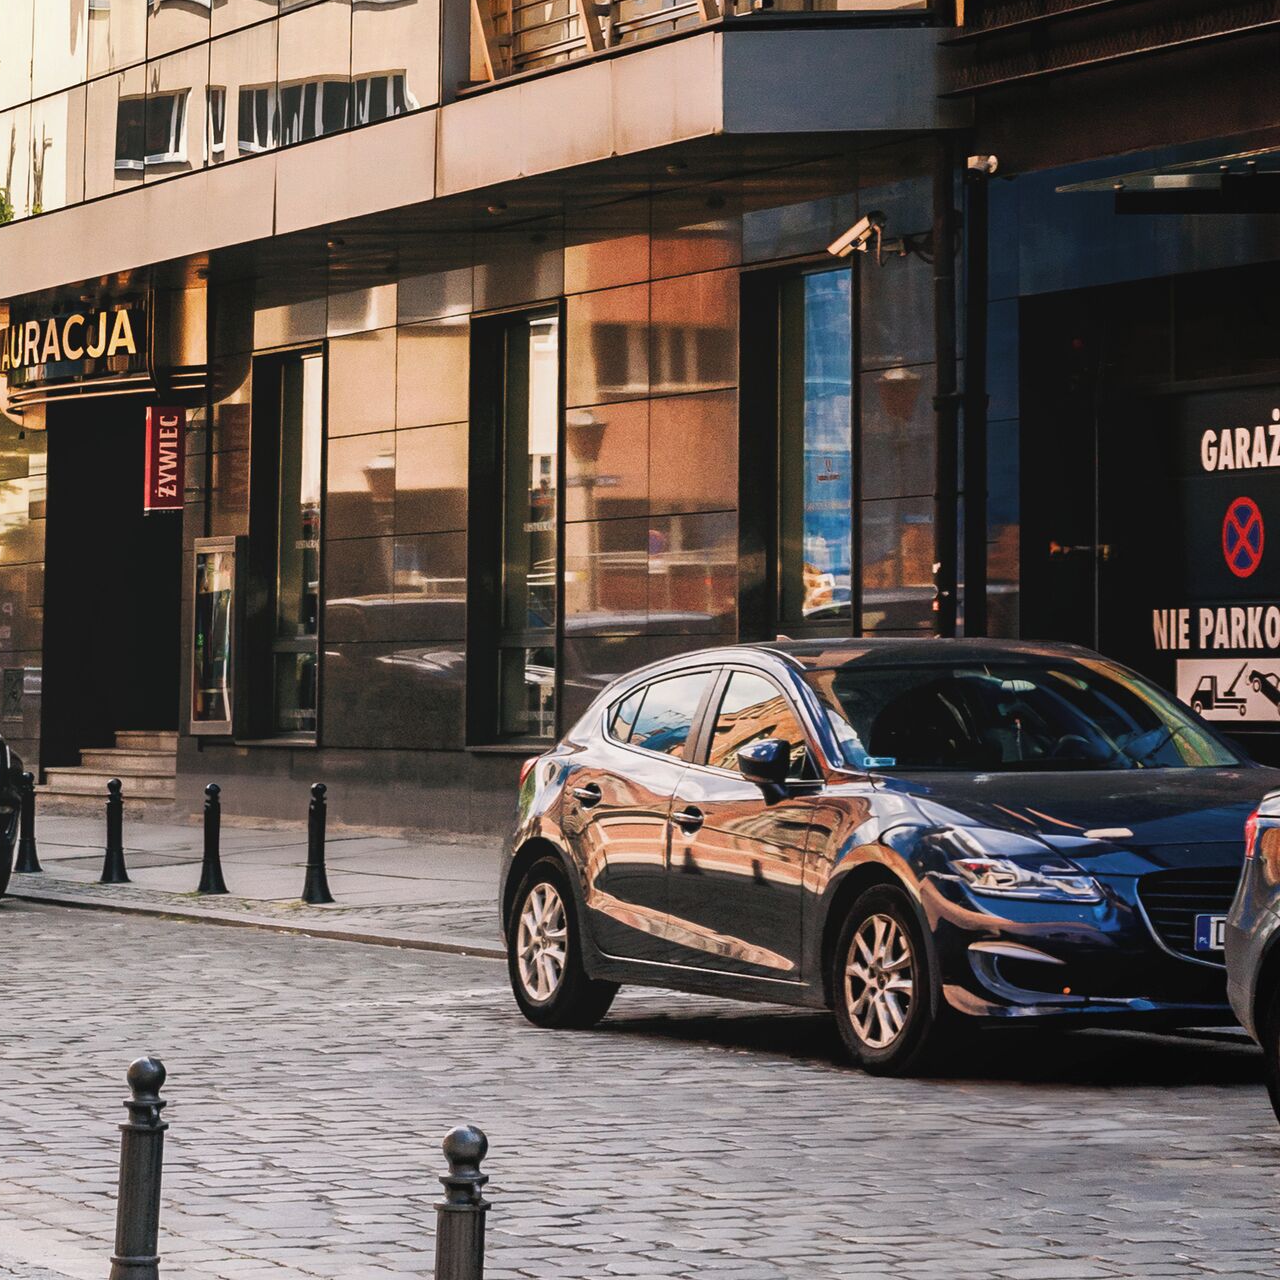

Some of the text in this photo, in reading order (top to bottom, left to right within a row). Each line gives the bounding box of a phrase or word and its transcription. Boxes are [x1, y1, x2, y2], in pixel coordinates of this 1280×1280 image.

[155, 415, 179, 498] ŻYWIEC
[1201, 408, 1280, 472] GARAŻ
[1152, 605, 1280, 649] NIE PARKO
